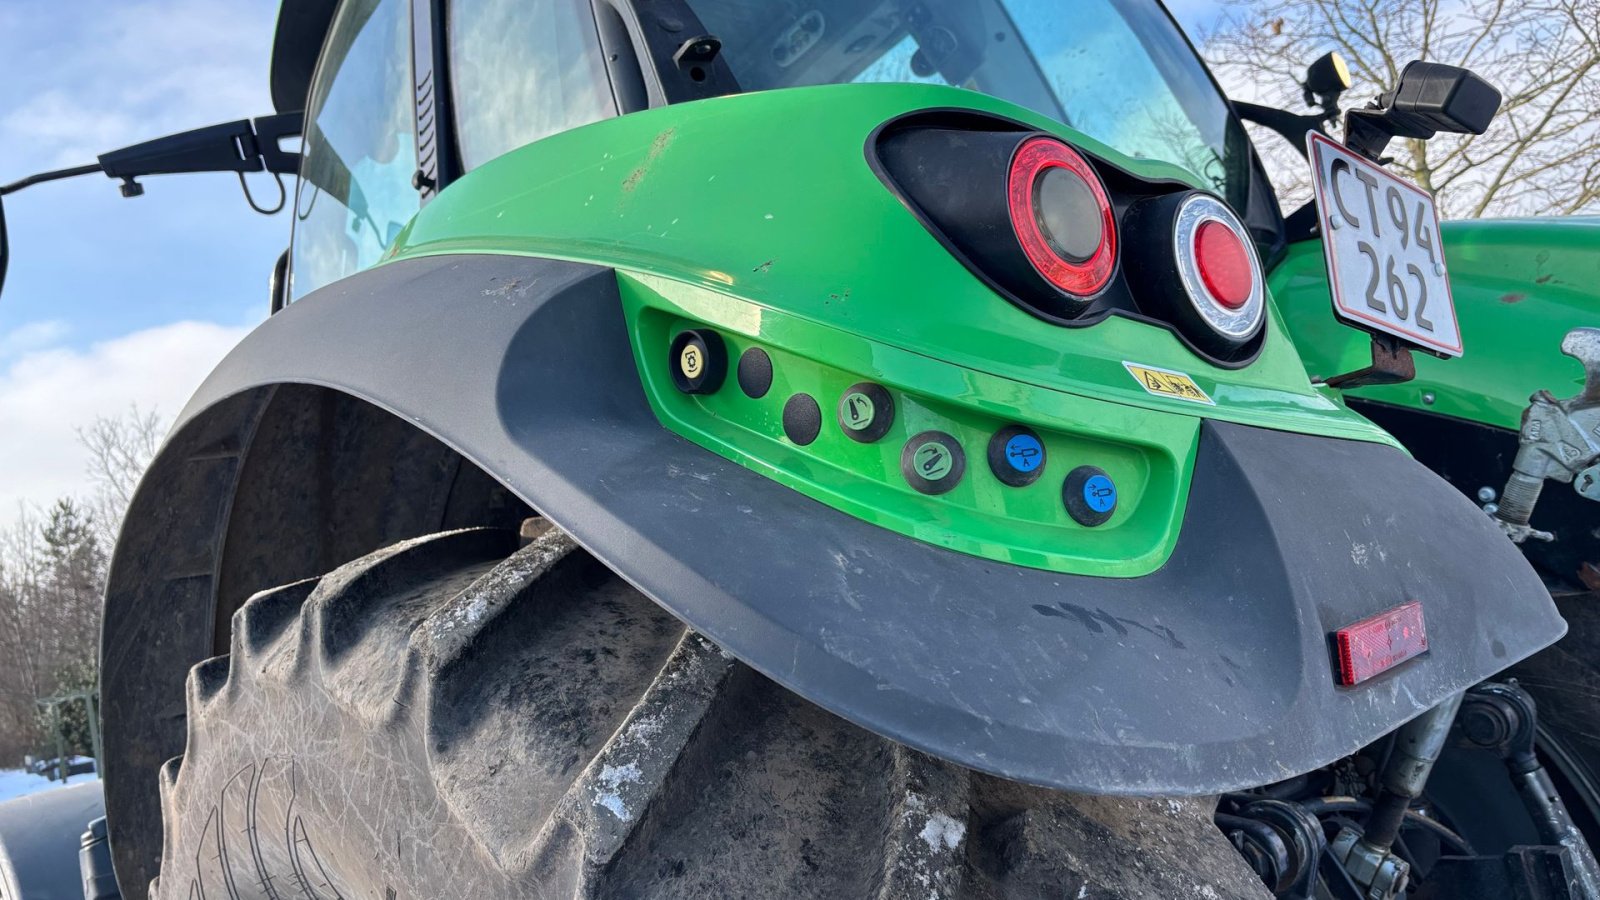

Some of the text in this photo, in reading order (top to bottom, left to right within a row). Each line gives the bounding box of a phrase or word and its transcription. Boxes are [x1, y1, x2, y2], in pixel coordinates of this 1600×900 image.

[1357, 240, 1434, 332] 262
[1023, 458, 1030, 467] A
[1099, 498, 1106, 507] A
